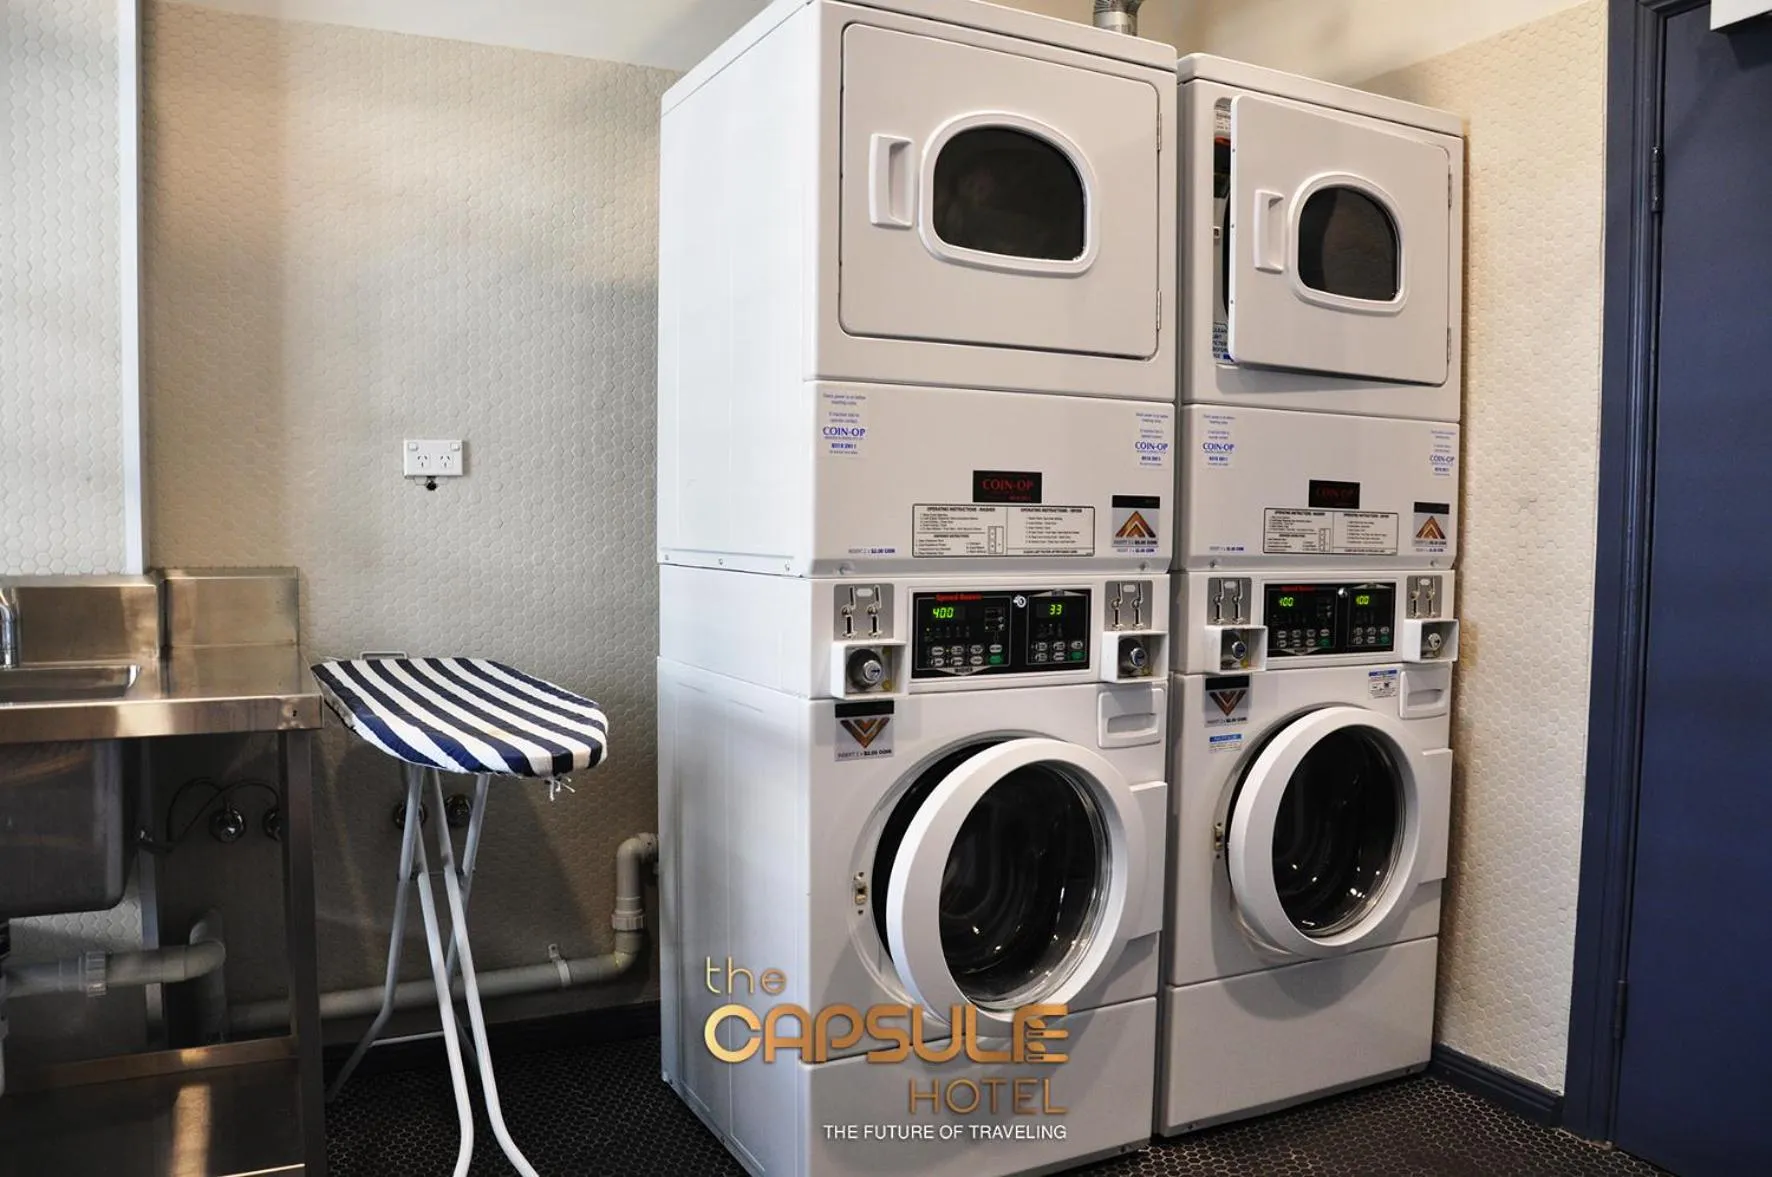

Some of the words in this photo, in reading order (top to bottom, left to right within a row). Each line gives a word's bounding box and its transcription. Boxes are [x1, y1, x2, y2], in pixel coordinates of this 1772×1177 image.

[823, 426, 866, 436] COIN-OP
[1135, 441, 1168, 450] COIN-OP
[981, 478, 1035, 491] COIN-OP
[932, 606, 955, 619] 400
[1049, 604, 1063, 615] 33
